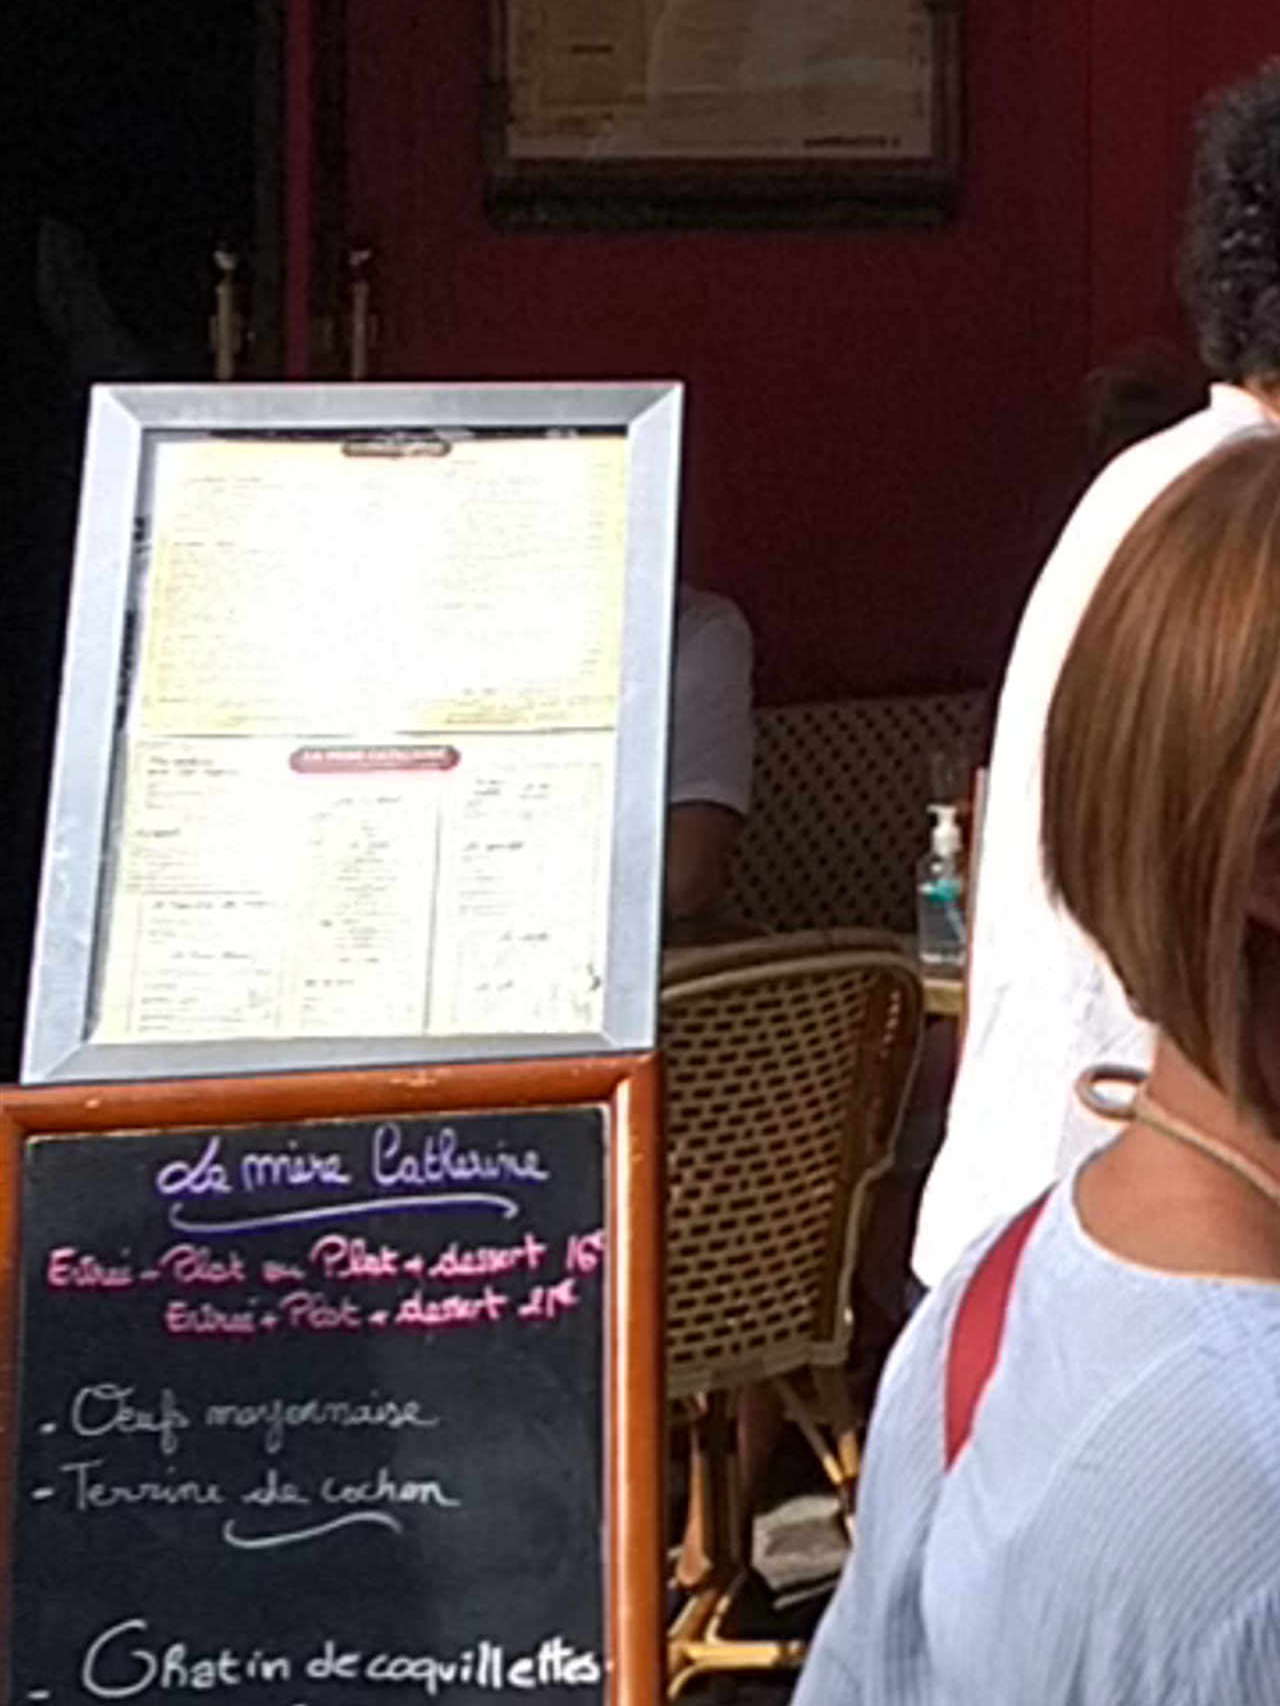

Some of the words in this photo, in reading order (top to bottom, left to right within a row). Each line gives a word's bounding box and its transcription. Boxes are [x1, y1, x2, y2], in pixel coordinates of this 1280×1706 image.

[309, 1233, 399, 1279] Plat
[59, 1459, 224, 1510] Terrine
[241, 1468, 309, 1506] de
